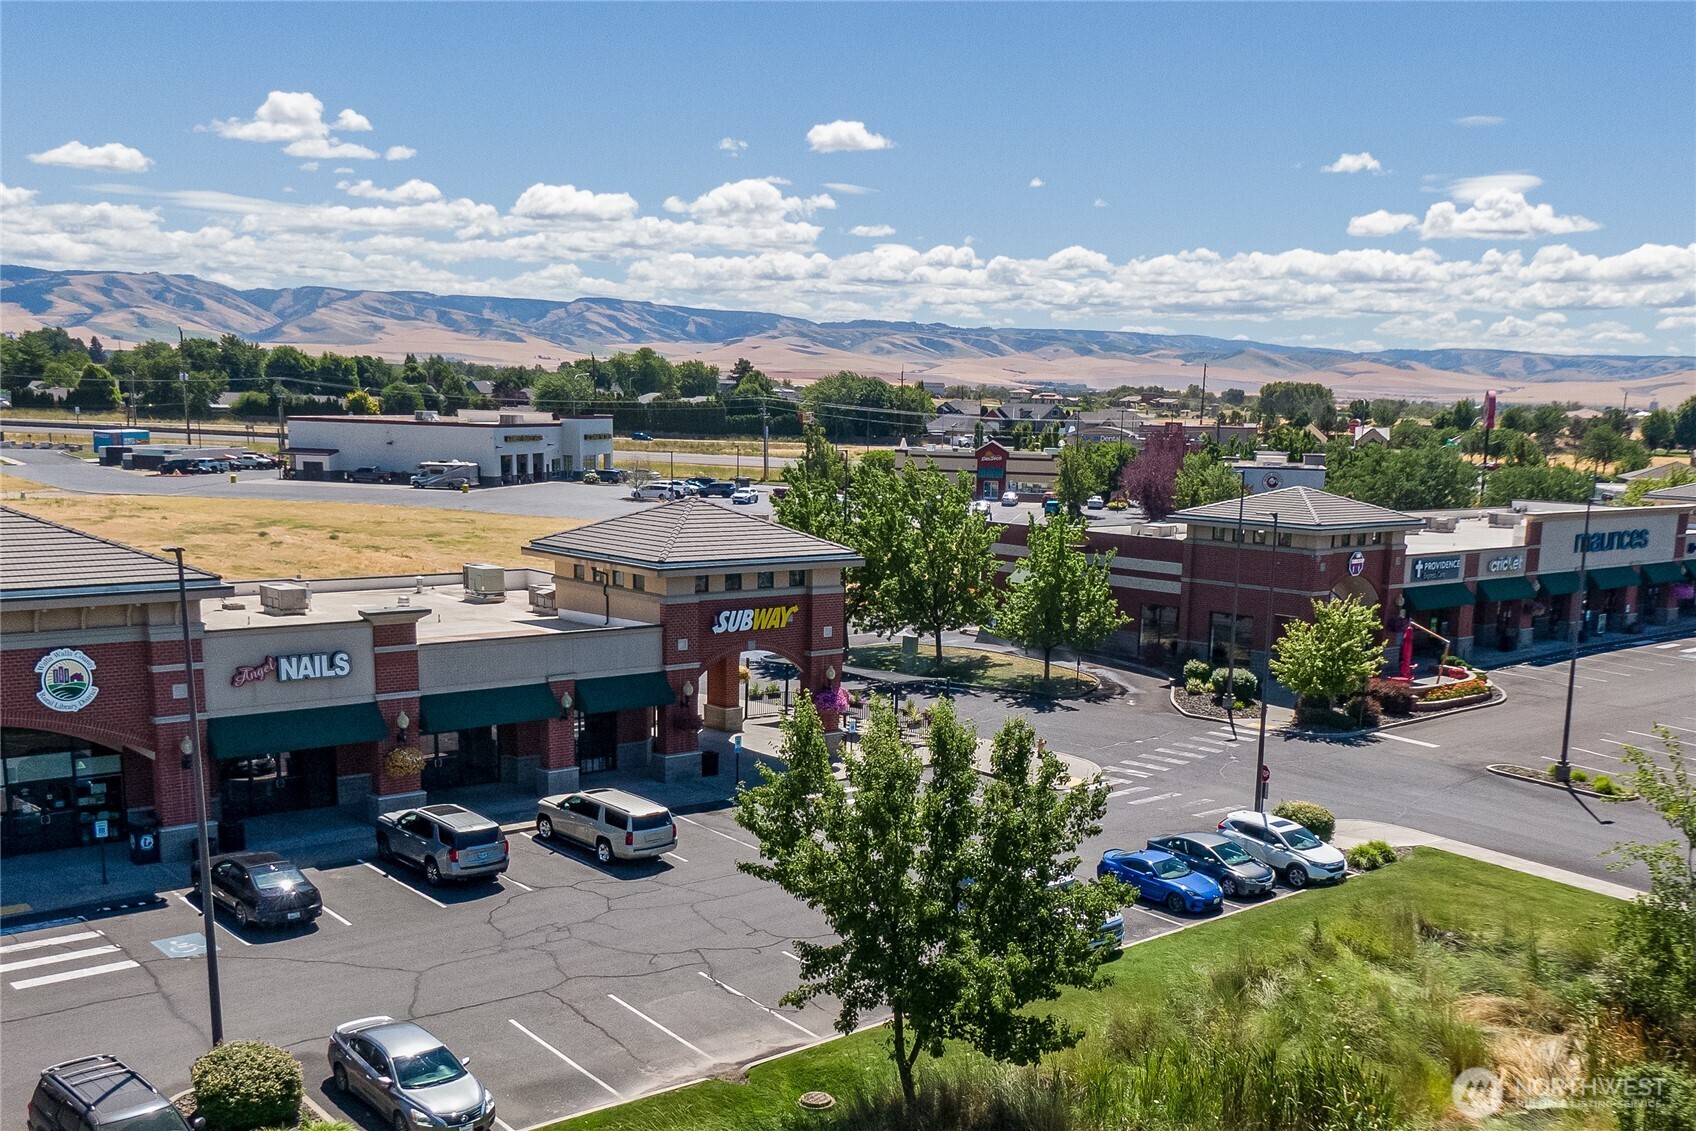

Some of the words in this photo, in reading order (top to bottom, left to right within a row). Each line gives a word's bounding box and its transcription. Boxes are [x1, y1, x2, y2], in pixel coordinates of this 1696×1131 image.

[1100, 434, 1120, 442] Dental
[1424, 560, 1460, 571] PROVIDENCE
[712, 605, 799, 634] SUBWAY
[37, 656, 54, 671] Walla
[54, 650, 73, 658] Walla
[234, 657, 276, 686] Angel
[280, 653, 351, 681] NAILS
